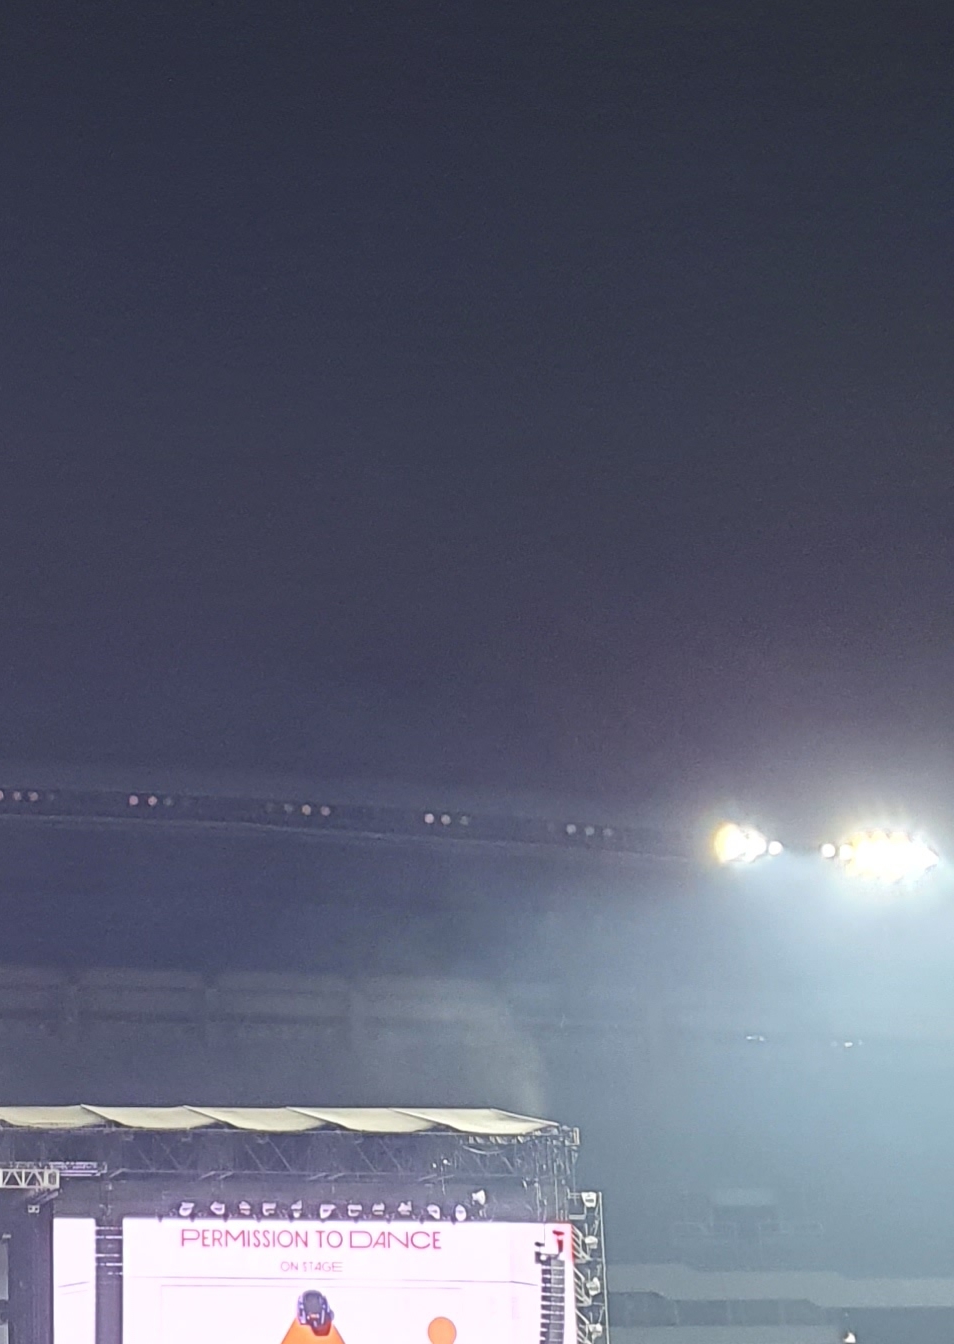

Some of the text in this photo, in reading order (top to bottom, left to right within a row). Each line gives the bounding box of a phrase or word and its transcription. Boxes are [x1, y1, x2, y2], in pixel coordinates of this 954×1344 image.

[181, 1229, 442, 1249] PERMISSION TO DANCE
[280, 1262, 343, 1272] ON STAGE
